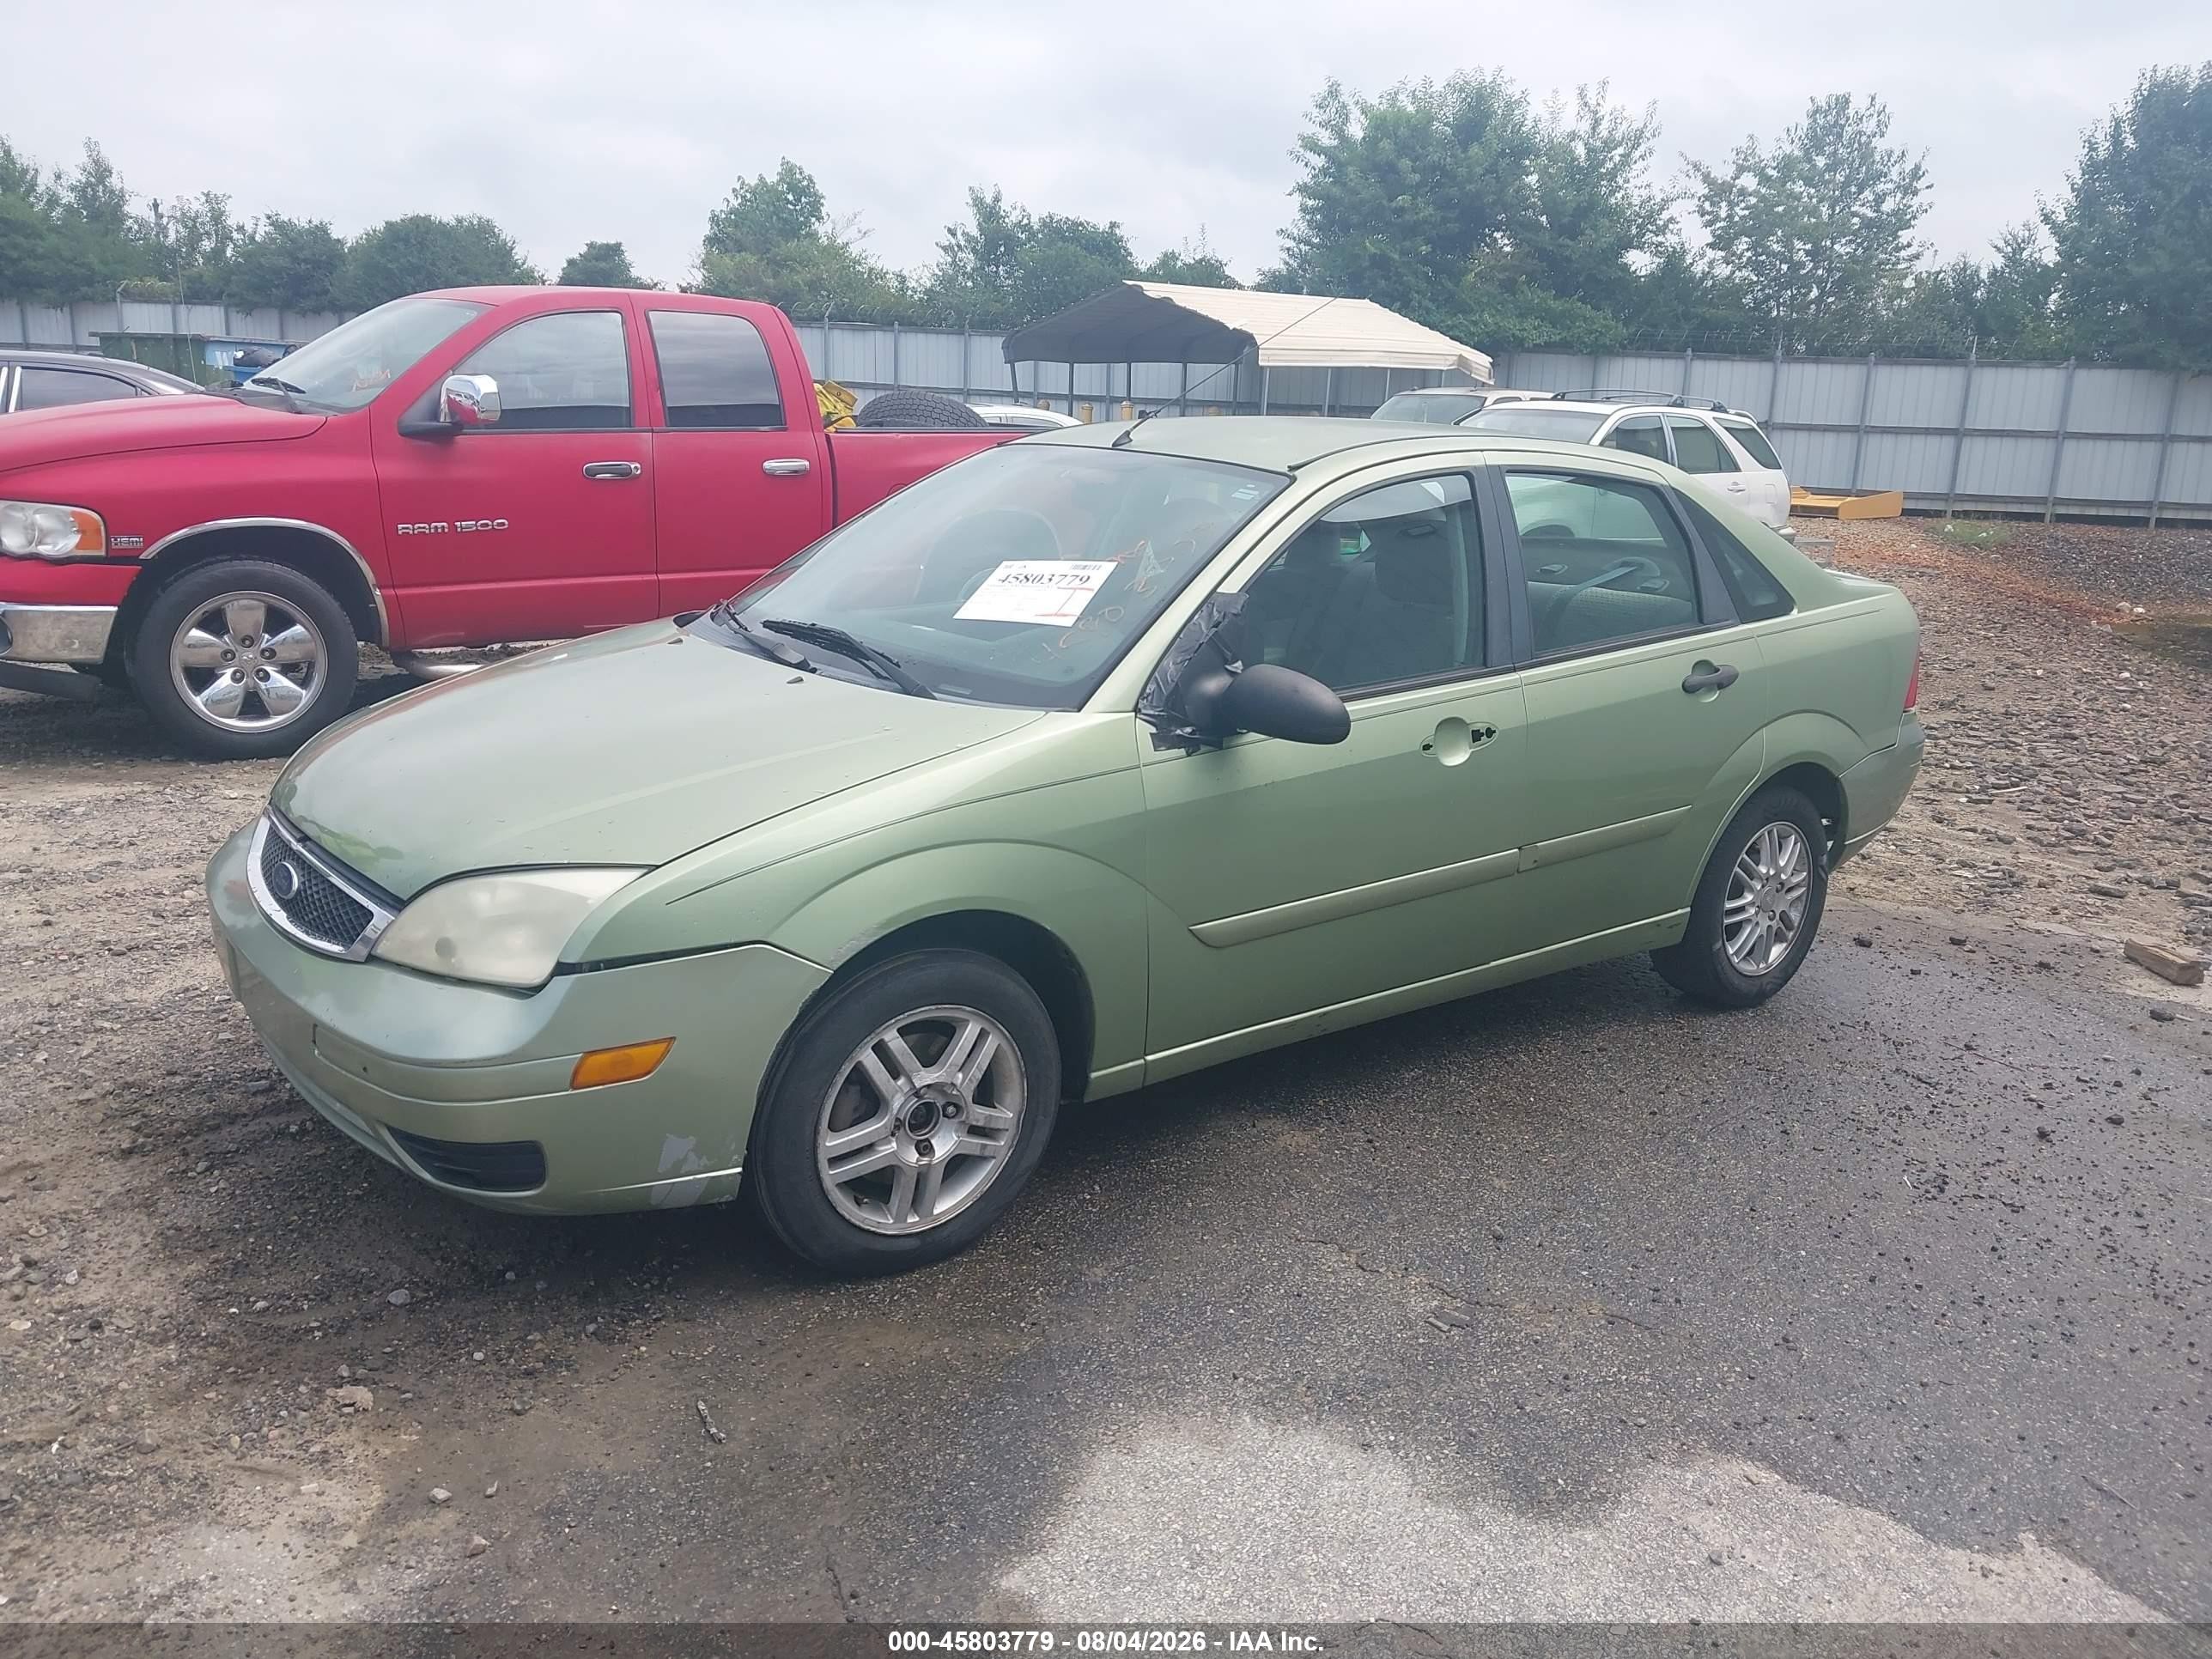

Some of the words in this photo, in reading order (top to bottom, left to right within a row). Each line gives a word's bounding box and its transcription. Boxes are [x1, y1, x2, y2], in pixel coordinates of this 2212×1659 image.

[398, 522, 449, 535] RAM
[454, 519, 509, 532] 1500
[111, 537, 144, 548] HEMI
[997, 573, 1092, 586] 45803779
